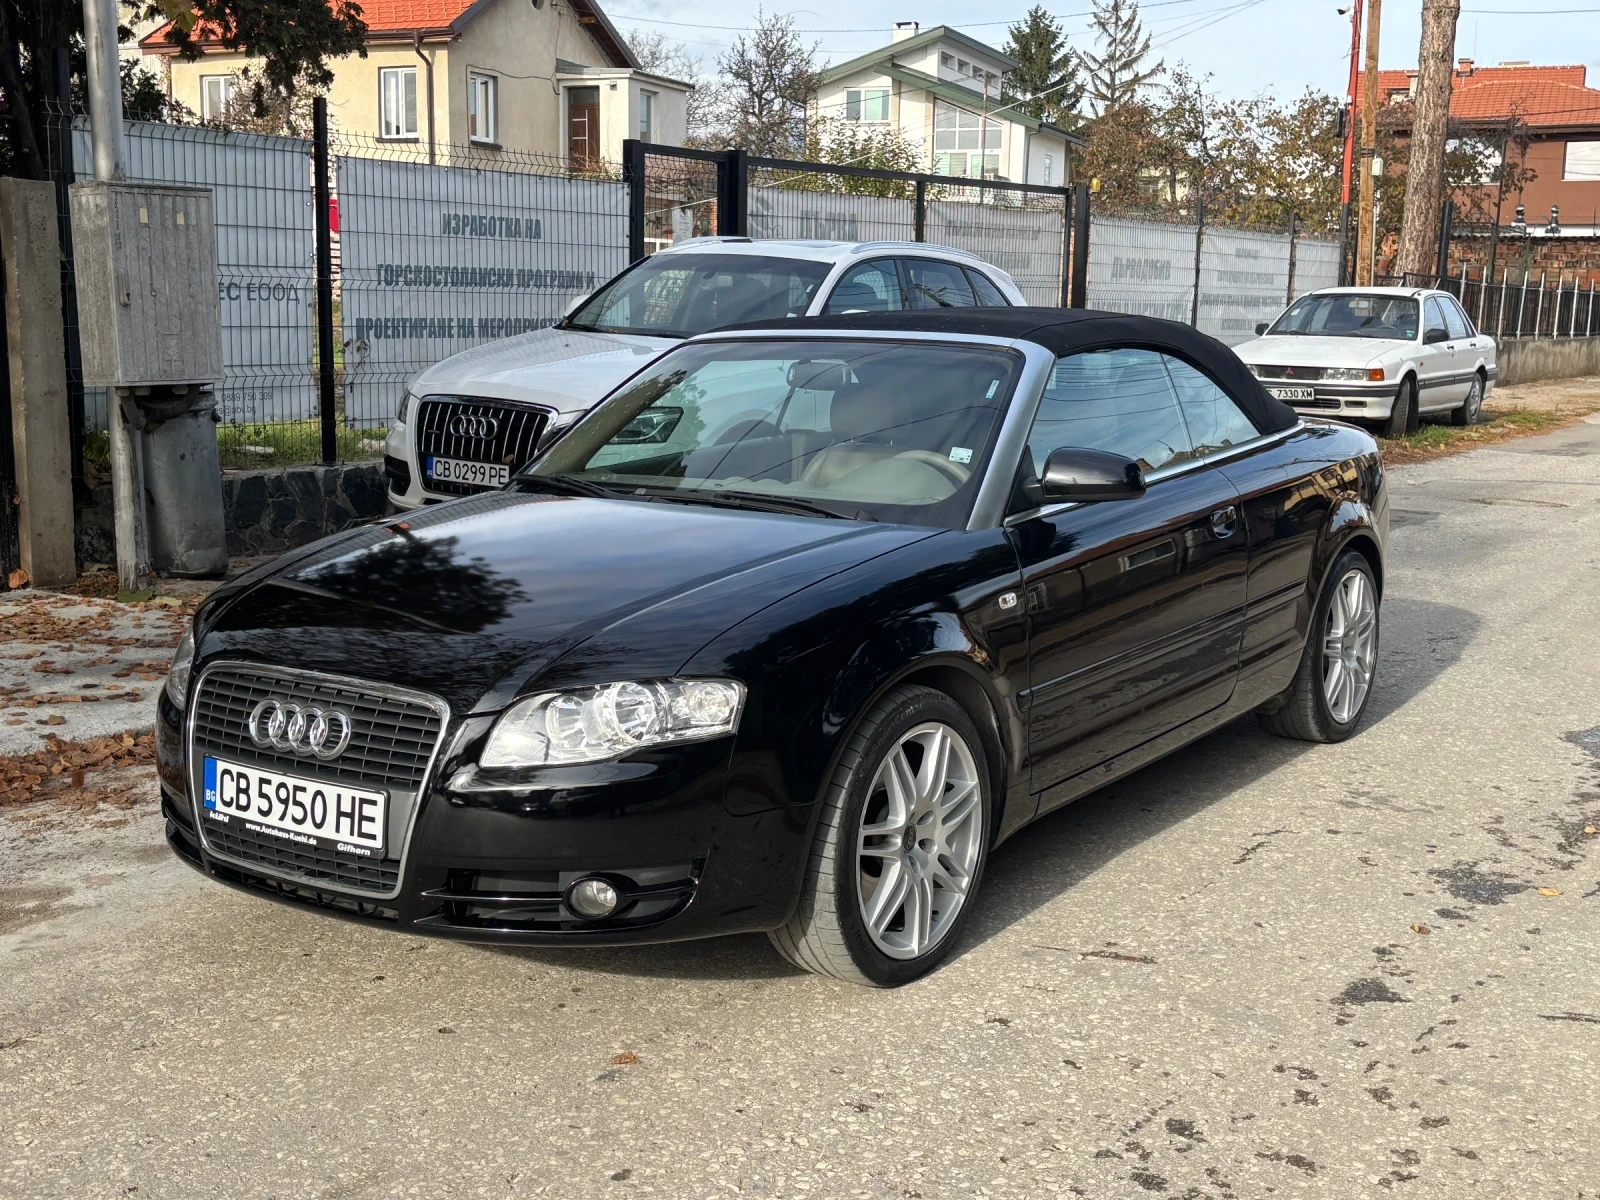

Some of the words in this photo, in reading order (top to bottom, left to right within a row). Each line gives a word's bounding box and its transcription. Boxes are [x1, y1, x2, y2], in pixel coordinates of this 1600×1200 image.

[442, 213, 522, 239] ИЗРАБОТКА
[524, 218, 542, 239] НА
[376, 263, 515, 289] ГОРСКОСТОПАНСКИ
[517, 269, 584, 290] ПРОГРАМИ
[586, 271, 595, 290] И
[246, 282, 300, 305] ЕООД
[355, 317, 455, 340] ПРОЕКТИРАНЕ
[456, 317, 476, 339] НА
[258, 390, 273, 401] 309
[1276, 389, 1299, 399] 7330
[215, 404, 257, 416] s@abv.bg
[434, 460, 452, 478] CB
[453, 462, 486, 482] 0299
[488, 466, 507, 485] PE
[205, 788, 216, 802] BG
[219, 768, 252, 813] CB
[257, 776, 328, 830] 5950
[335, 793, 378, 841] HE
[245, 822, 317, 846] www.Autohaus-Kuehl.de
[337, 842, 371, 856] Gifhorn
